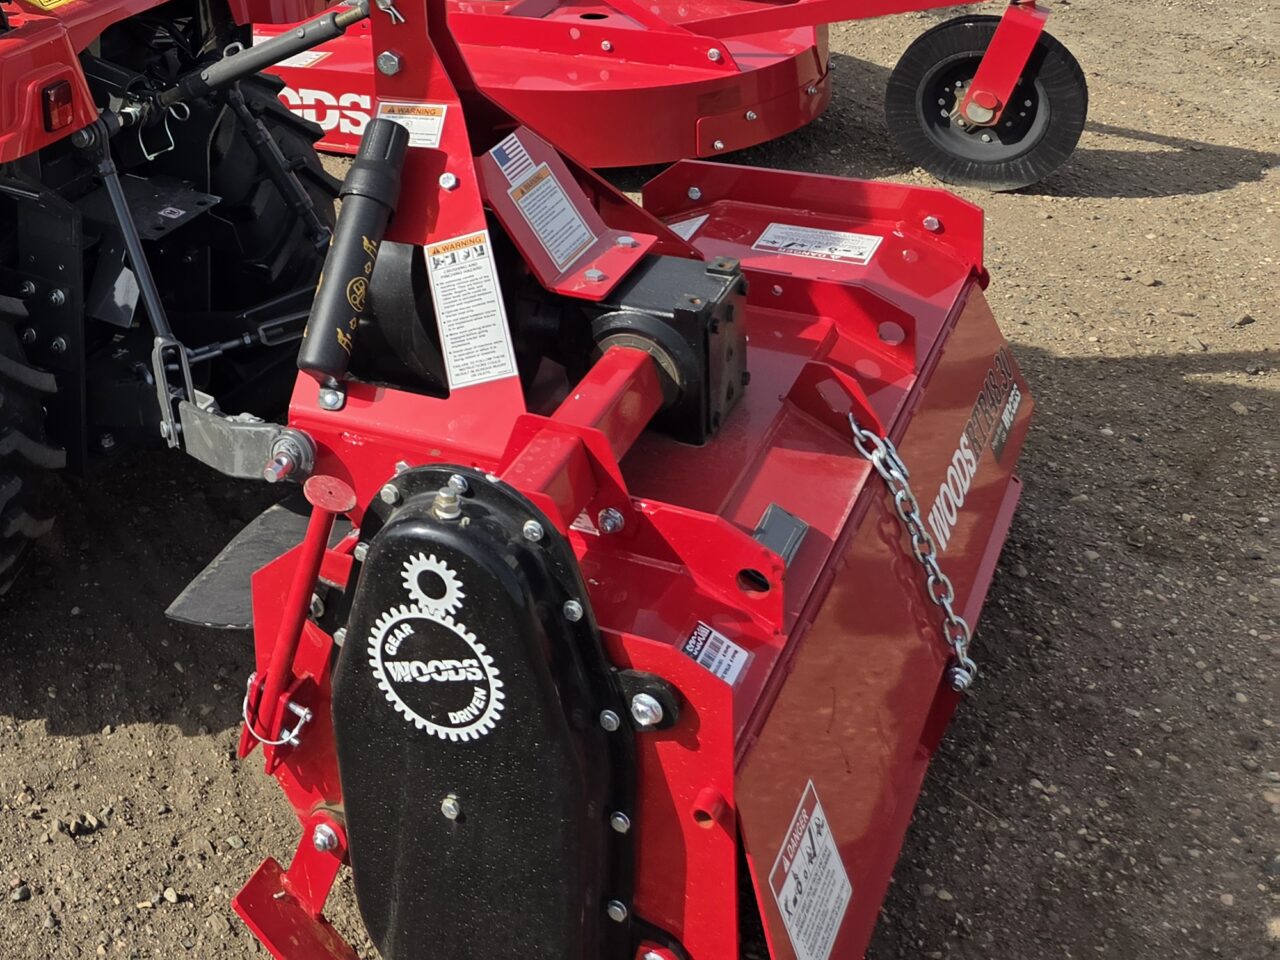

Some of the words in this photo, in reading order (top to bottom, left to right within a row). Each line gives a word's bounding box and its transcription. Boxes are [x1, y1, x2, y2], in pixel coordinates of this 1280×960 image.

[397, 107, 437, 116] WARNING
[441, 236, 482, 253] WARNING
[928, 431, 977, 552] WOODS
[384, 622, 416, 657] GEAR
[384, 658, 484, 683] WOODS
[448, 685, 488, 725] DRIVEN
[786, 807, 810, 858] DANGER
